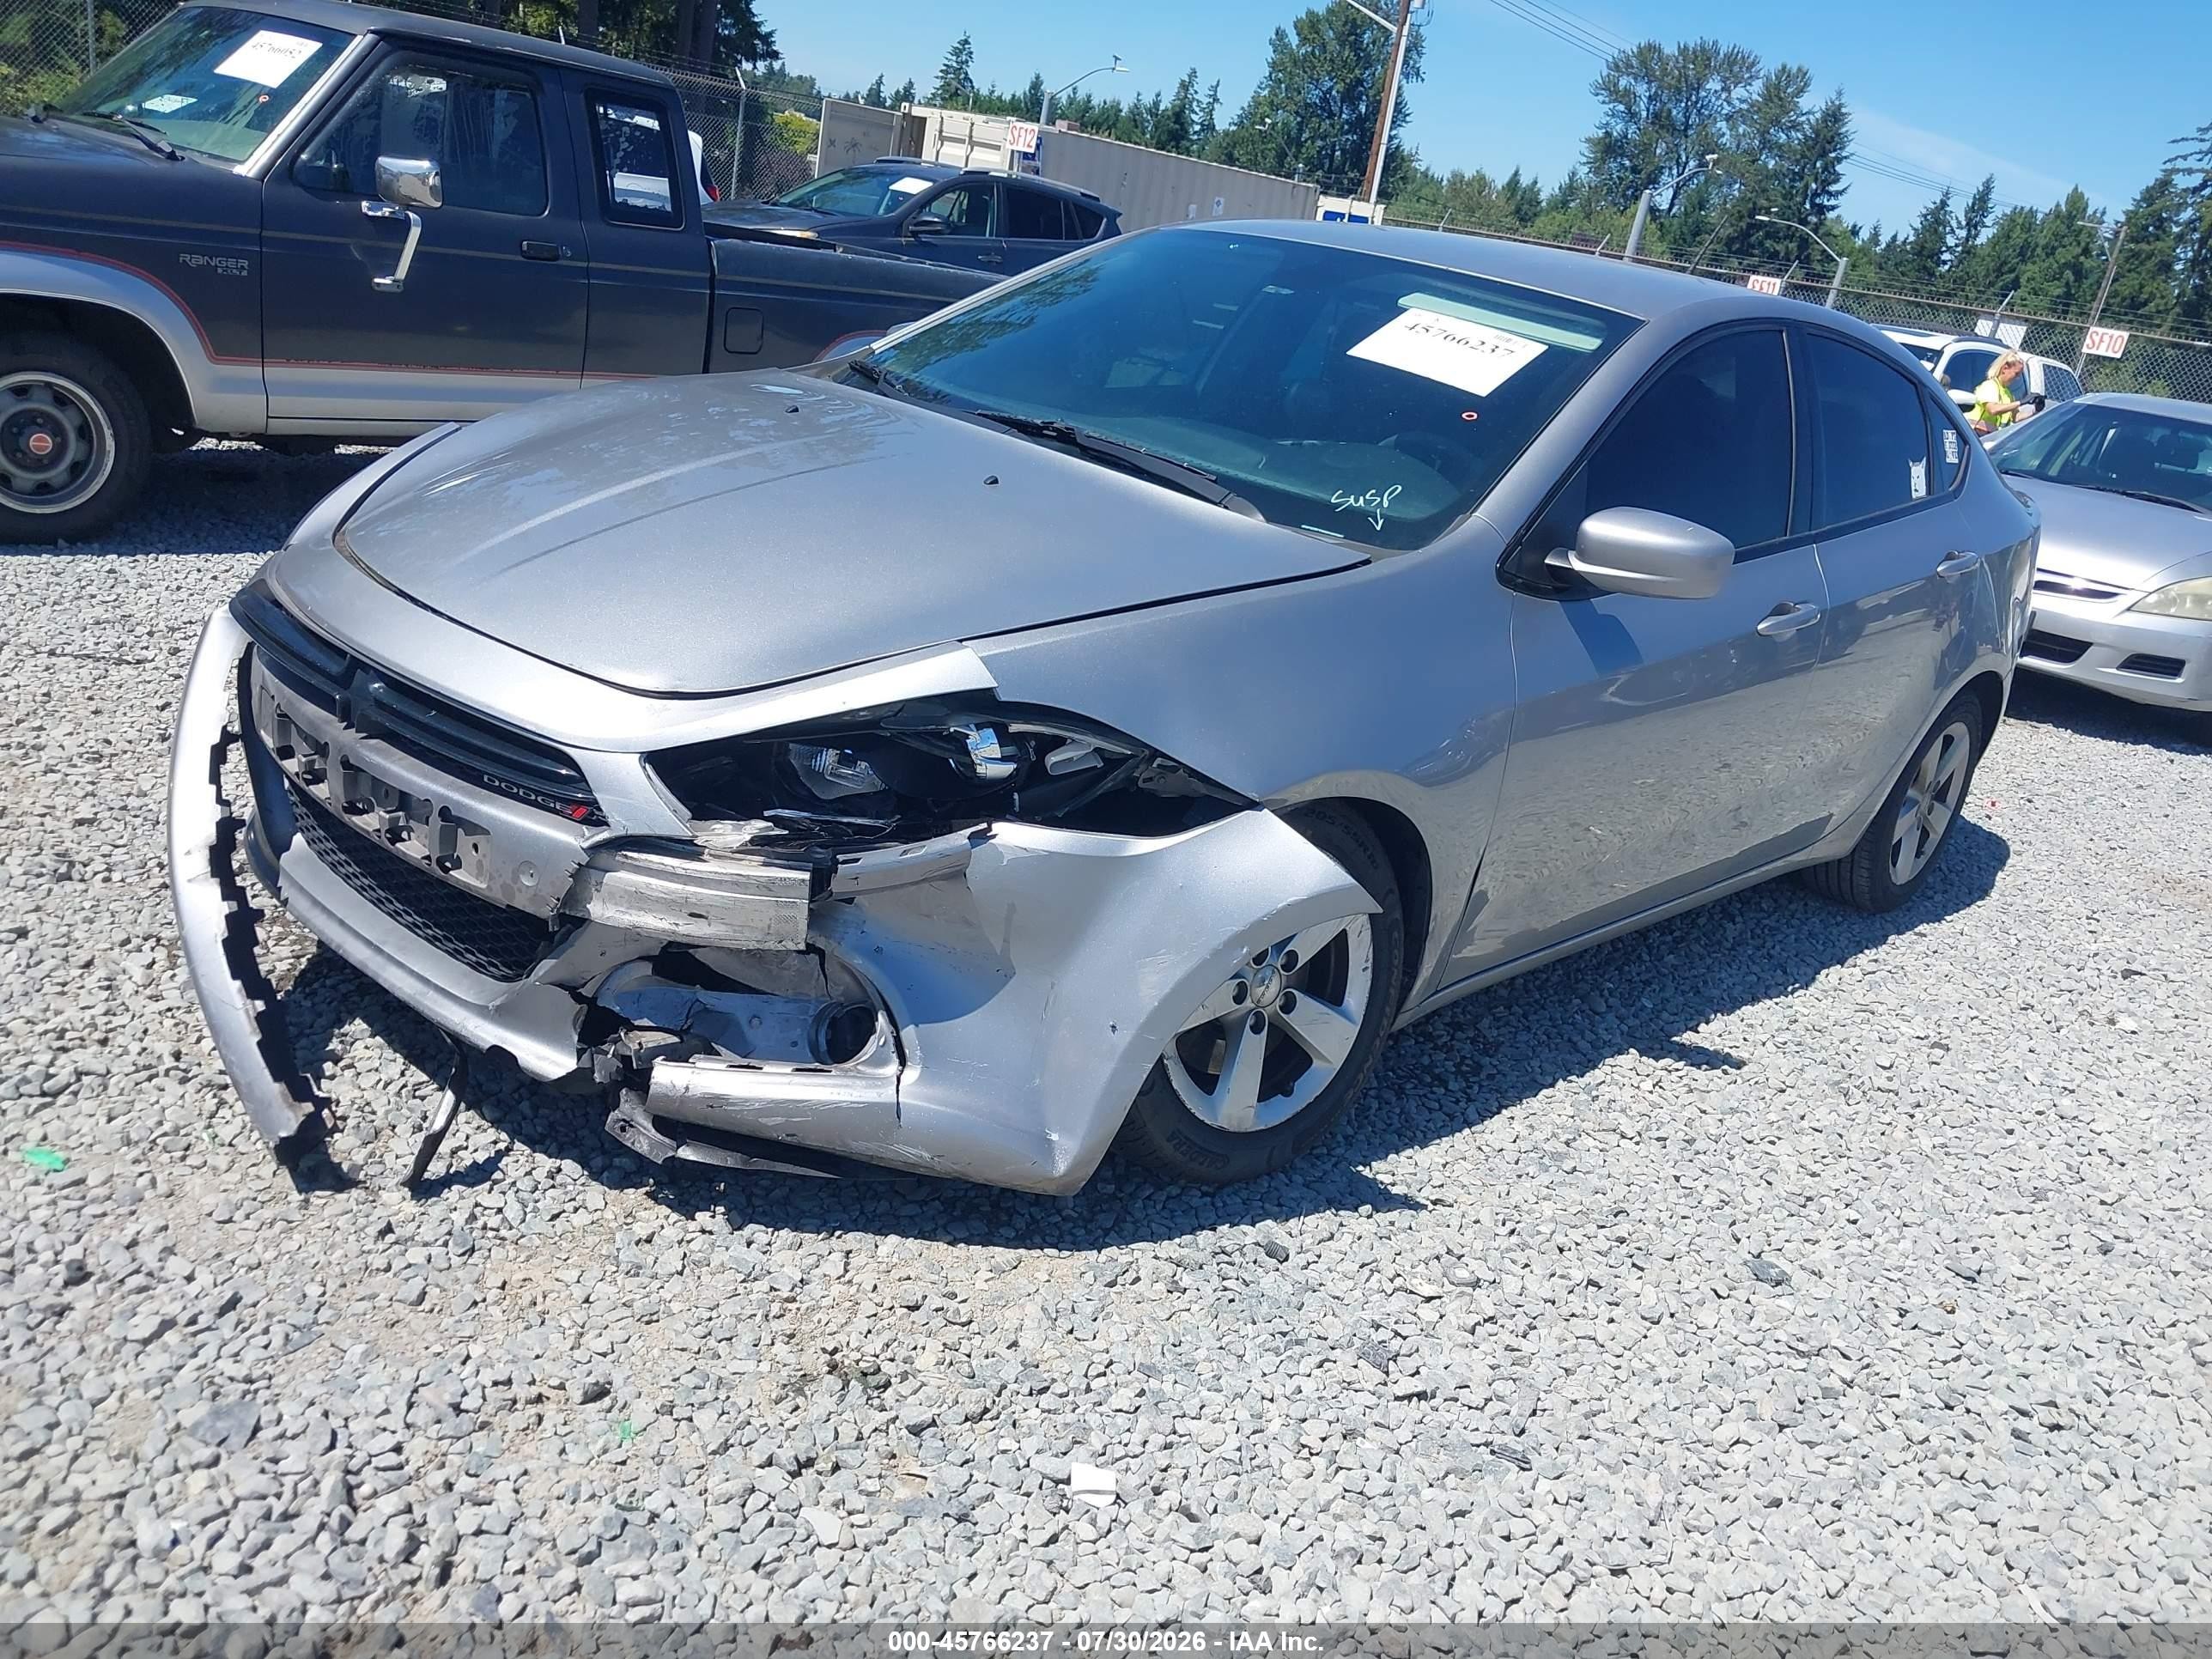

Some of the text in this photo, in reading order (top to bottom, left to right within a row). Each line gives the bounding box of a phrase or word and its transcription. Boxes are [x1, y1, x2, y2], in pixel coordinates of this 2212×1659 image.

[1009, 125, 1036, 148] SF12
[179, 253, 249, 270] RANGER
[1404, 322, 1516, 358] 45766237
[2086, 331, 2125, 354] SF10
[483, 774, 574, 815] DODGE
